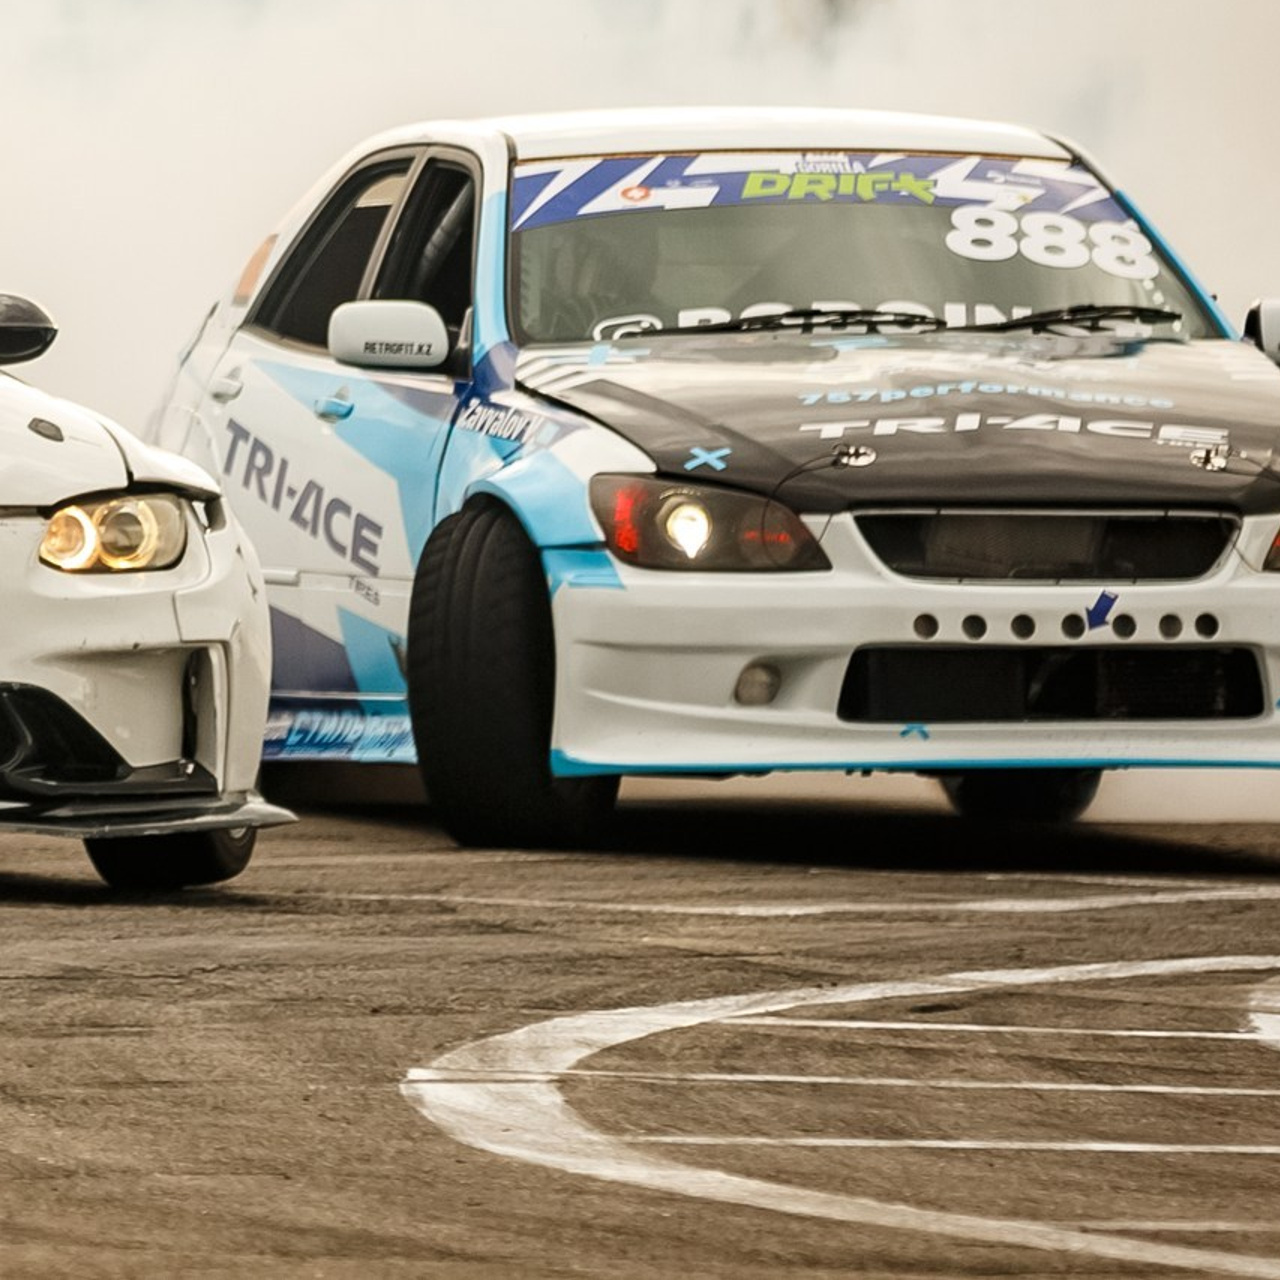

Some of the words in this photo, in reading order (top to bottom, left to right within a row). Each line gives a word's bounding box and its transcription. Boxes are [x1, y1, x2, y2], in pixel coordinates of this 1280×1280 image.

[945, 204, 1160, 280] 888
[363, 341, 433, 356] RETROFIT.KZ
[799, 412, 1230, 445] TRI-ACE
[223, 418, 383, 578] TRI-ACE
